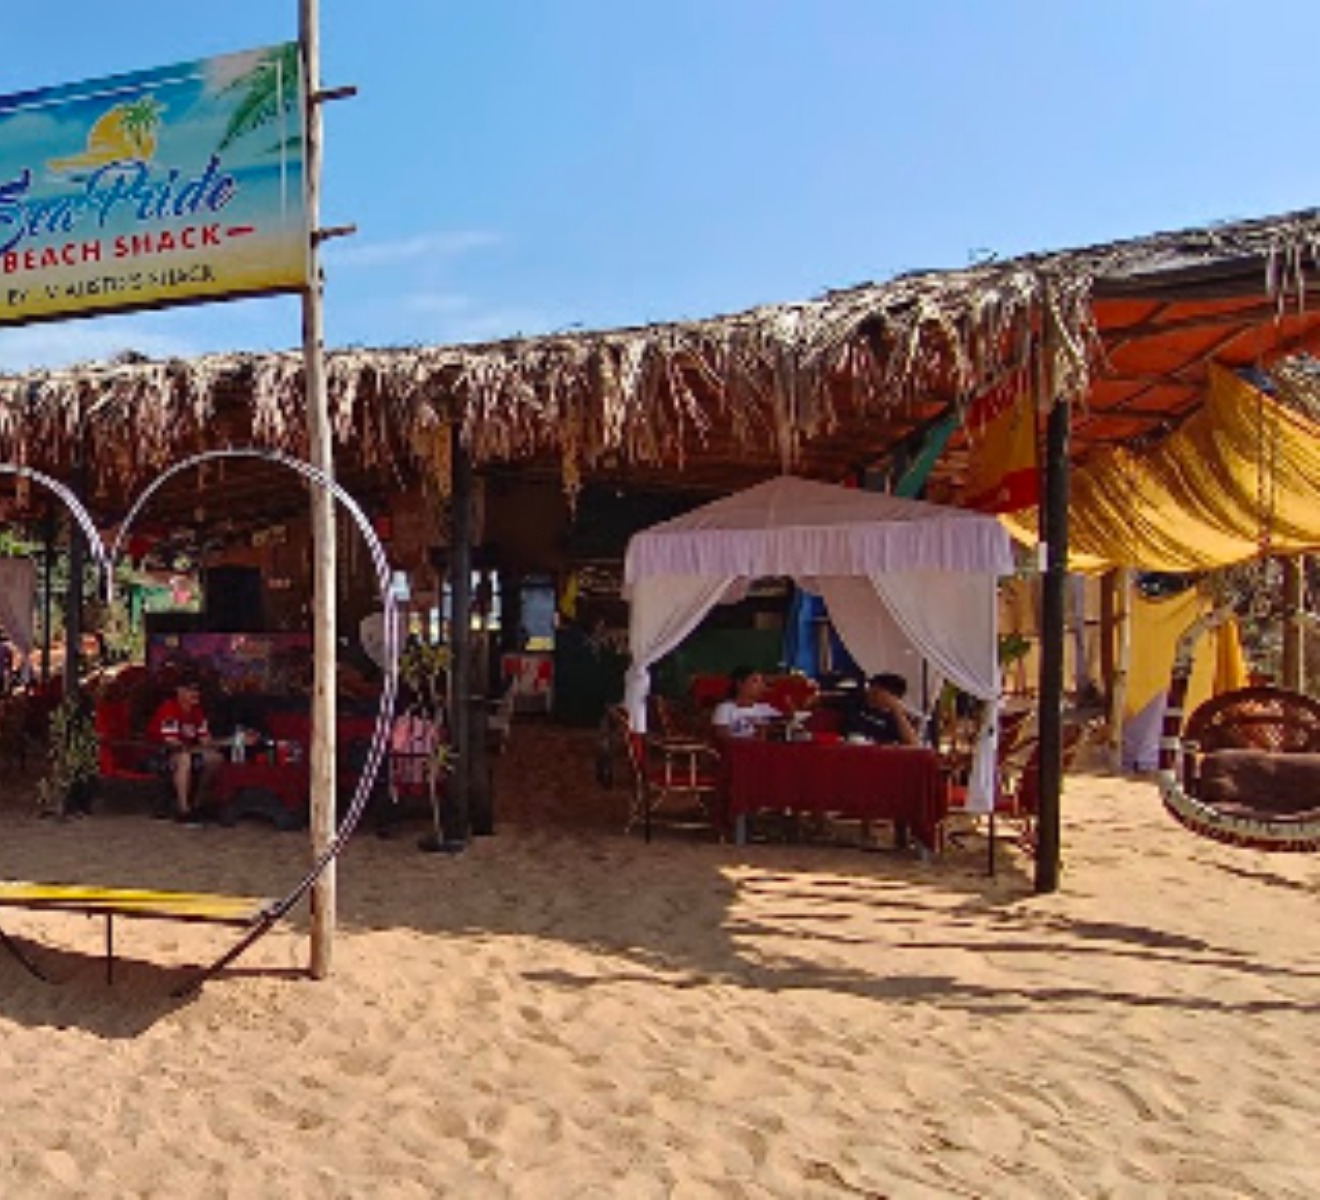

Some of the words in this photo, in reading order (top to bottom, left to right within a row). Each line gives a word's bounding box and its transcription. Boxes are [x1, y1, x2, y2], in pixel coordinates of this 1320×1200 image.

[85, 153, 235, 228] Pride
[3, 240, 101, 273] BEACH
[114, 223, 221, 258] SHACK
